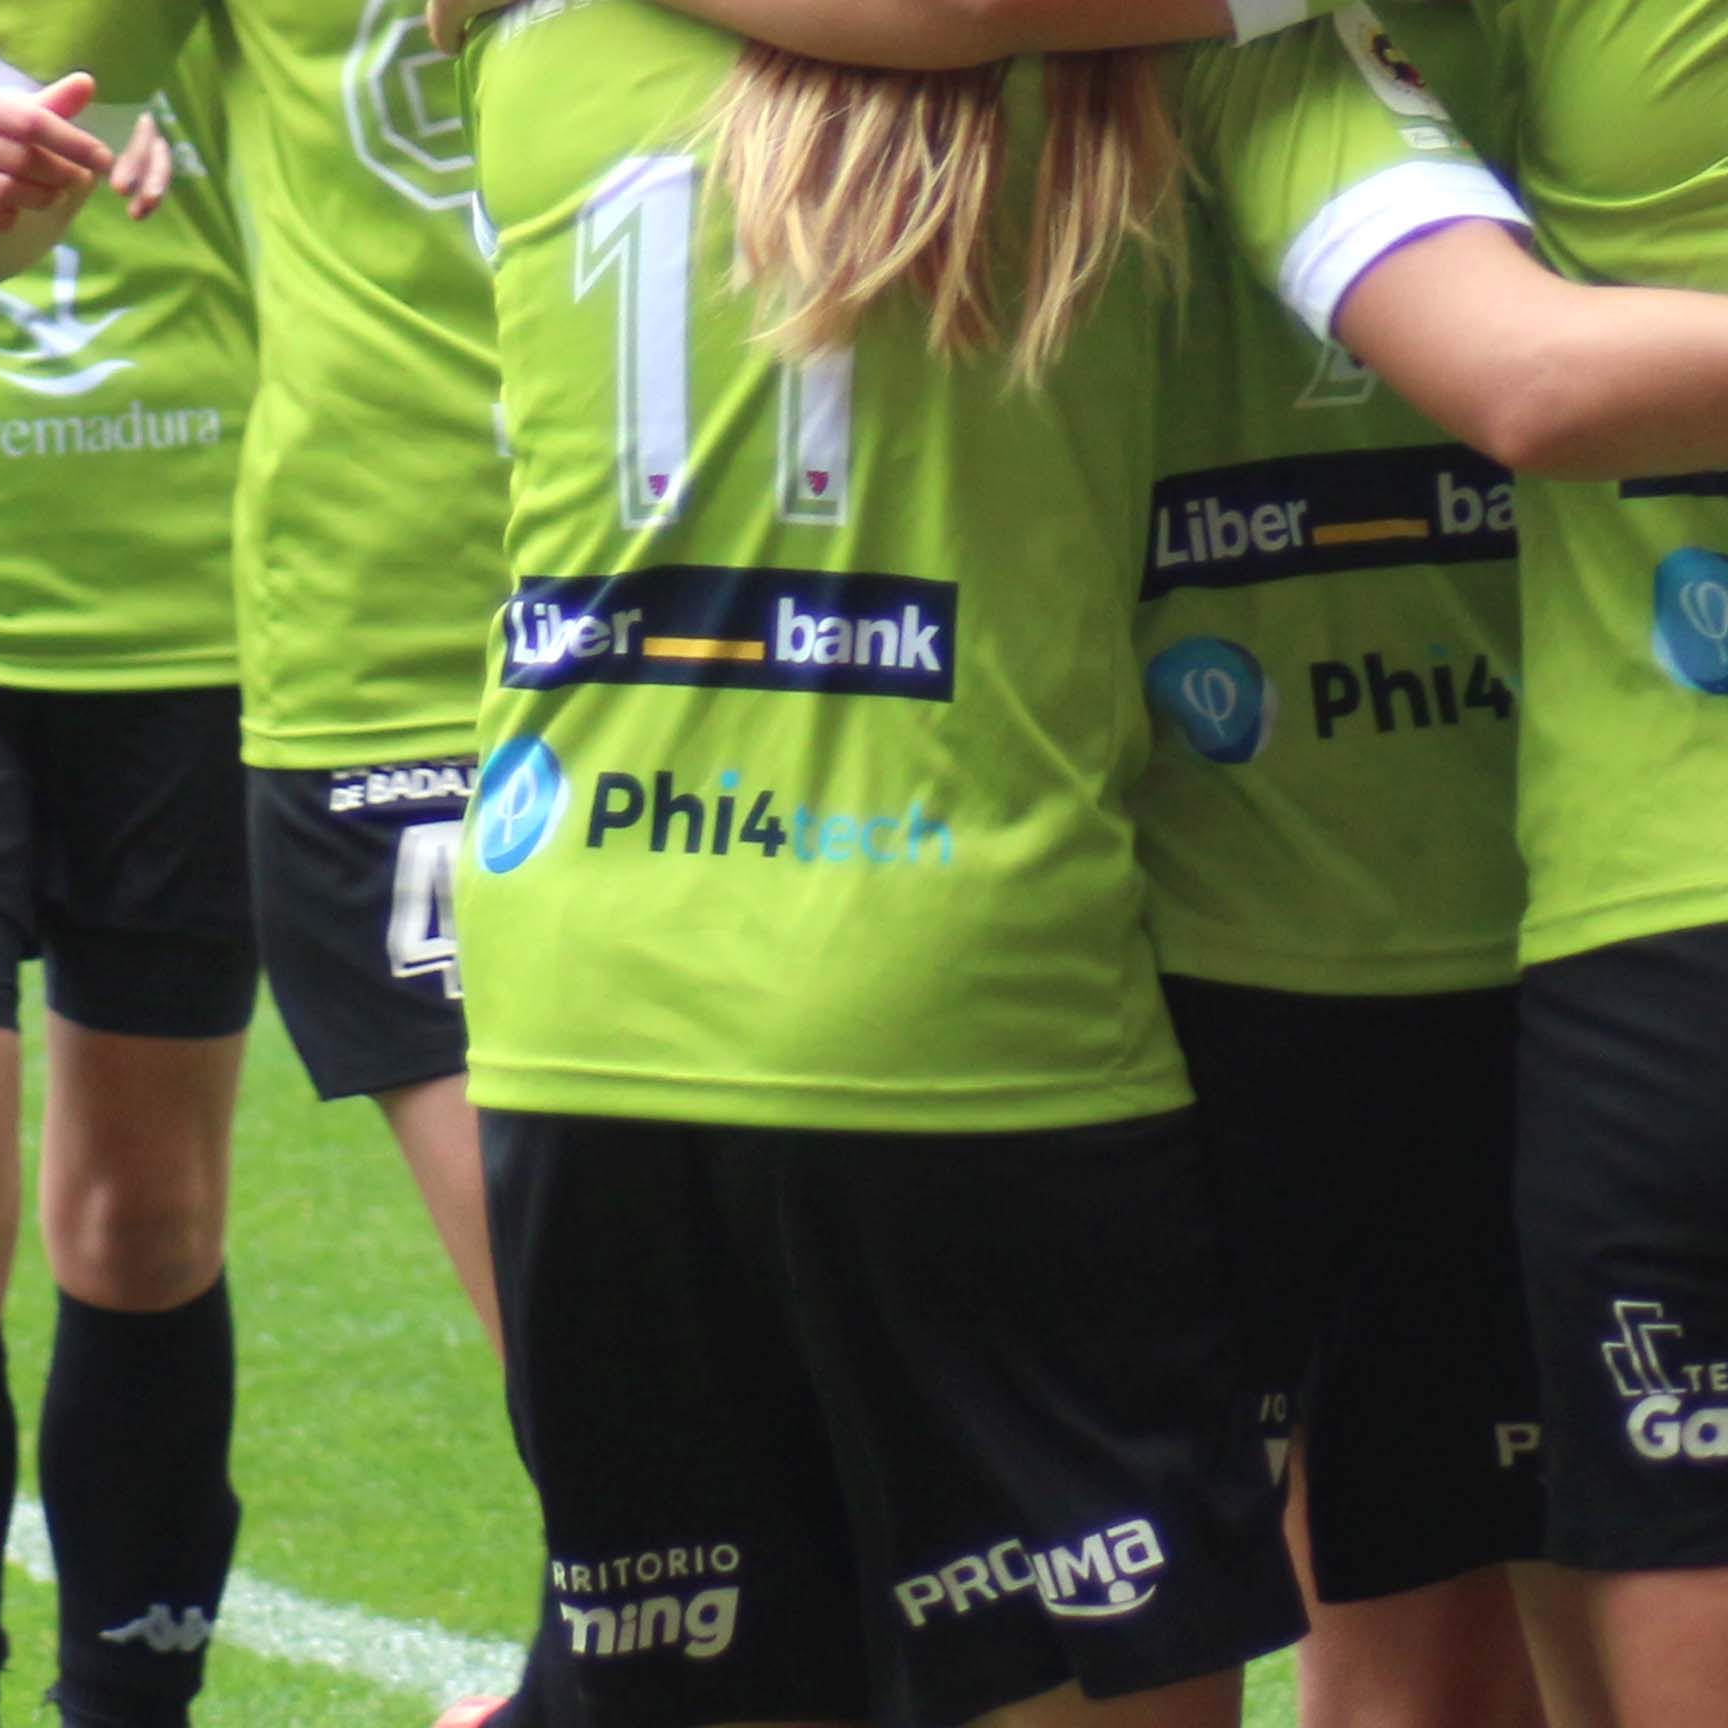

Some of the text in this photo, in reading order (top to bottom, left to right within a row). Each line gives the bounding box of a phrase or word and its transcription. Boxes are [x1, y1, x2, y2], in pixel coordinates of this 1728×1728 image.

[1155, 472, 1516, 568] Liber ba
[510, 597, 943, 672] Liber bank
[1308, 642, 1516, 740] Phi4
[366, 767, 478, 805] BADA
[585, 768, 954, 865] Phi4tech
[551, 1543, 741, 1593] RRITORIO
[559, 1586, 741, 1660] ming
